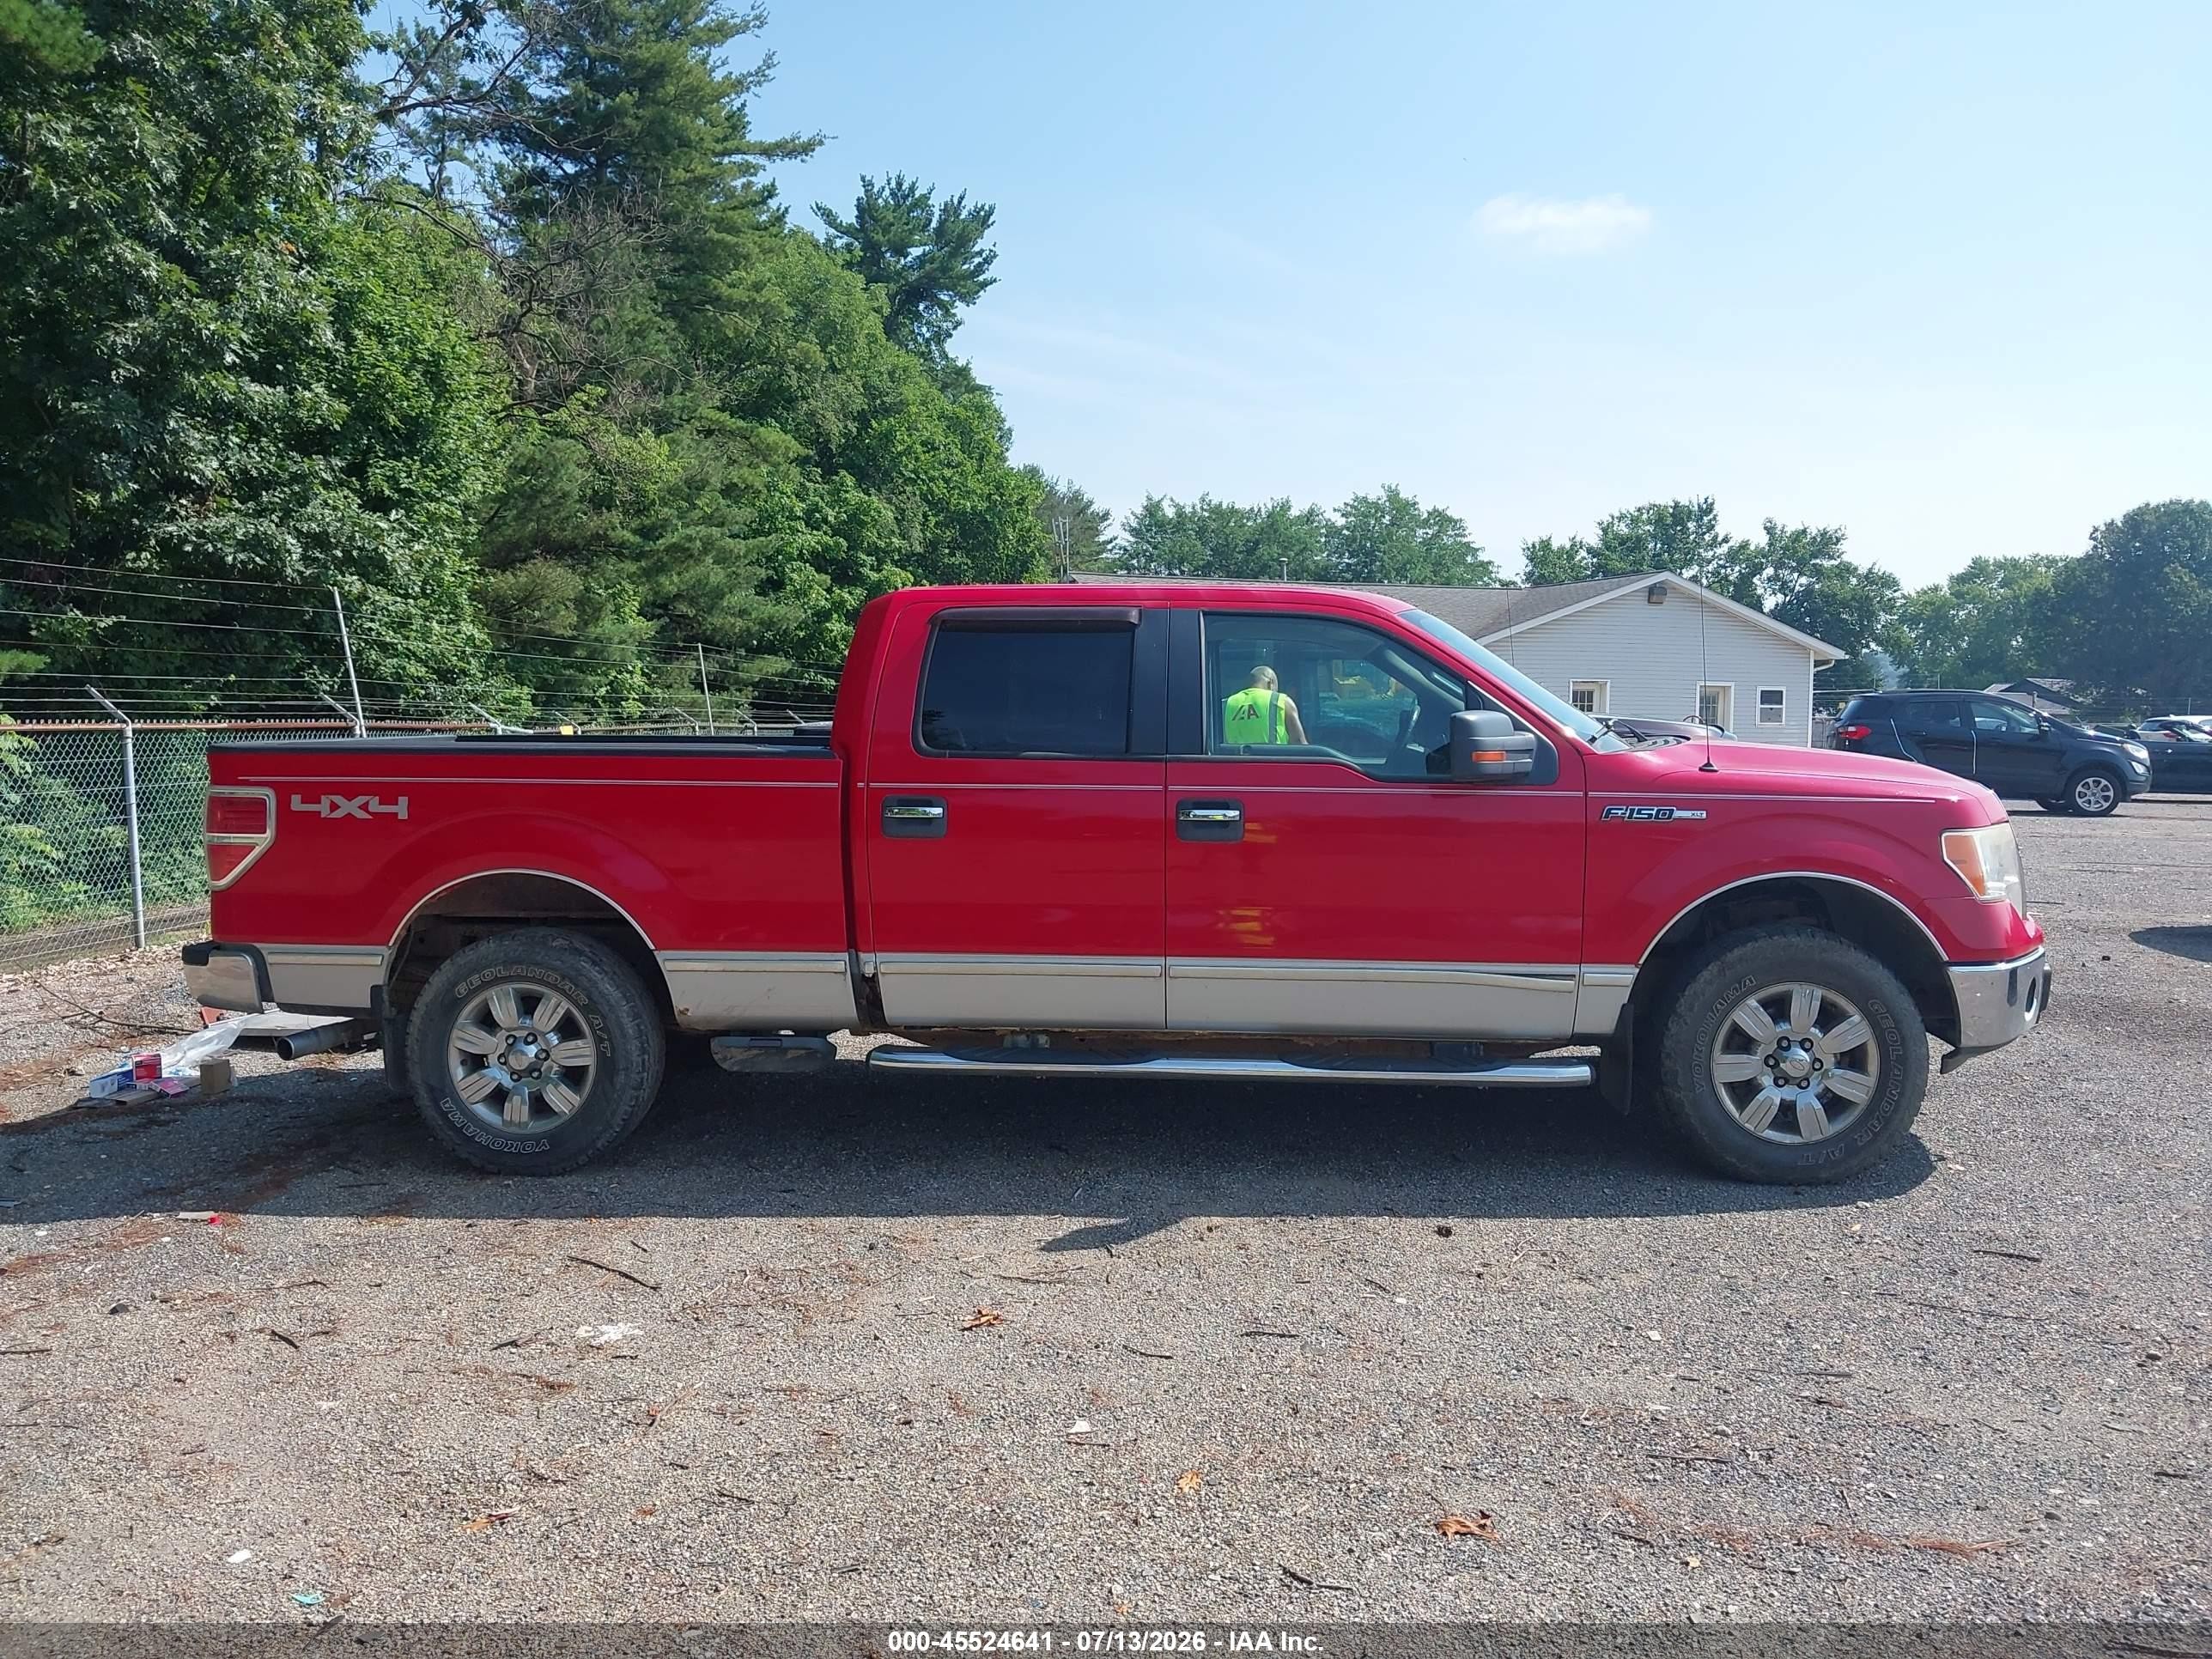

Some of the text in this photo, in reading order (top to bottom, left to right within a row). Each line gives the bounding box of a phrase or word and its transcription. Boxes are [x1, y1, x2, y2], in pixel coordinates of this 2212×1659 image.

[1601, 805, 1676, 821] F-150
[454, 964, 611, 1057] GEOLANDAR A/T
[1690, 975, 1758, 1094] YOKOHAMA
[1854, 998, 1904, 1146] GEOLANDAR
[439, 1097, 550, 1153] YOKOHAMA
